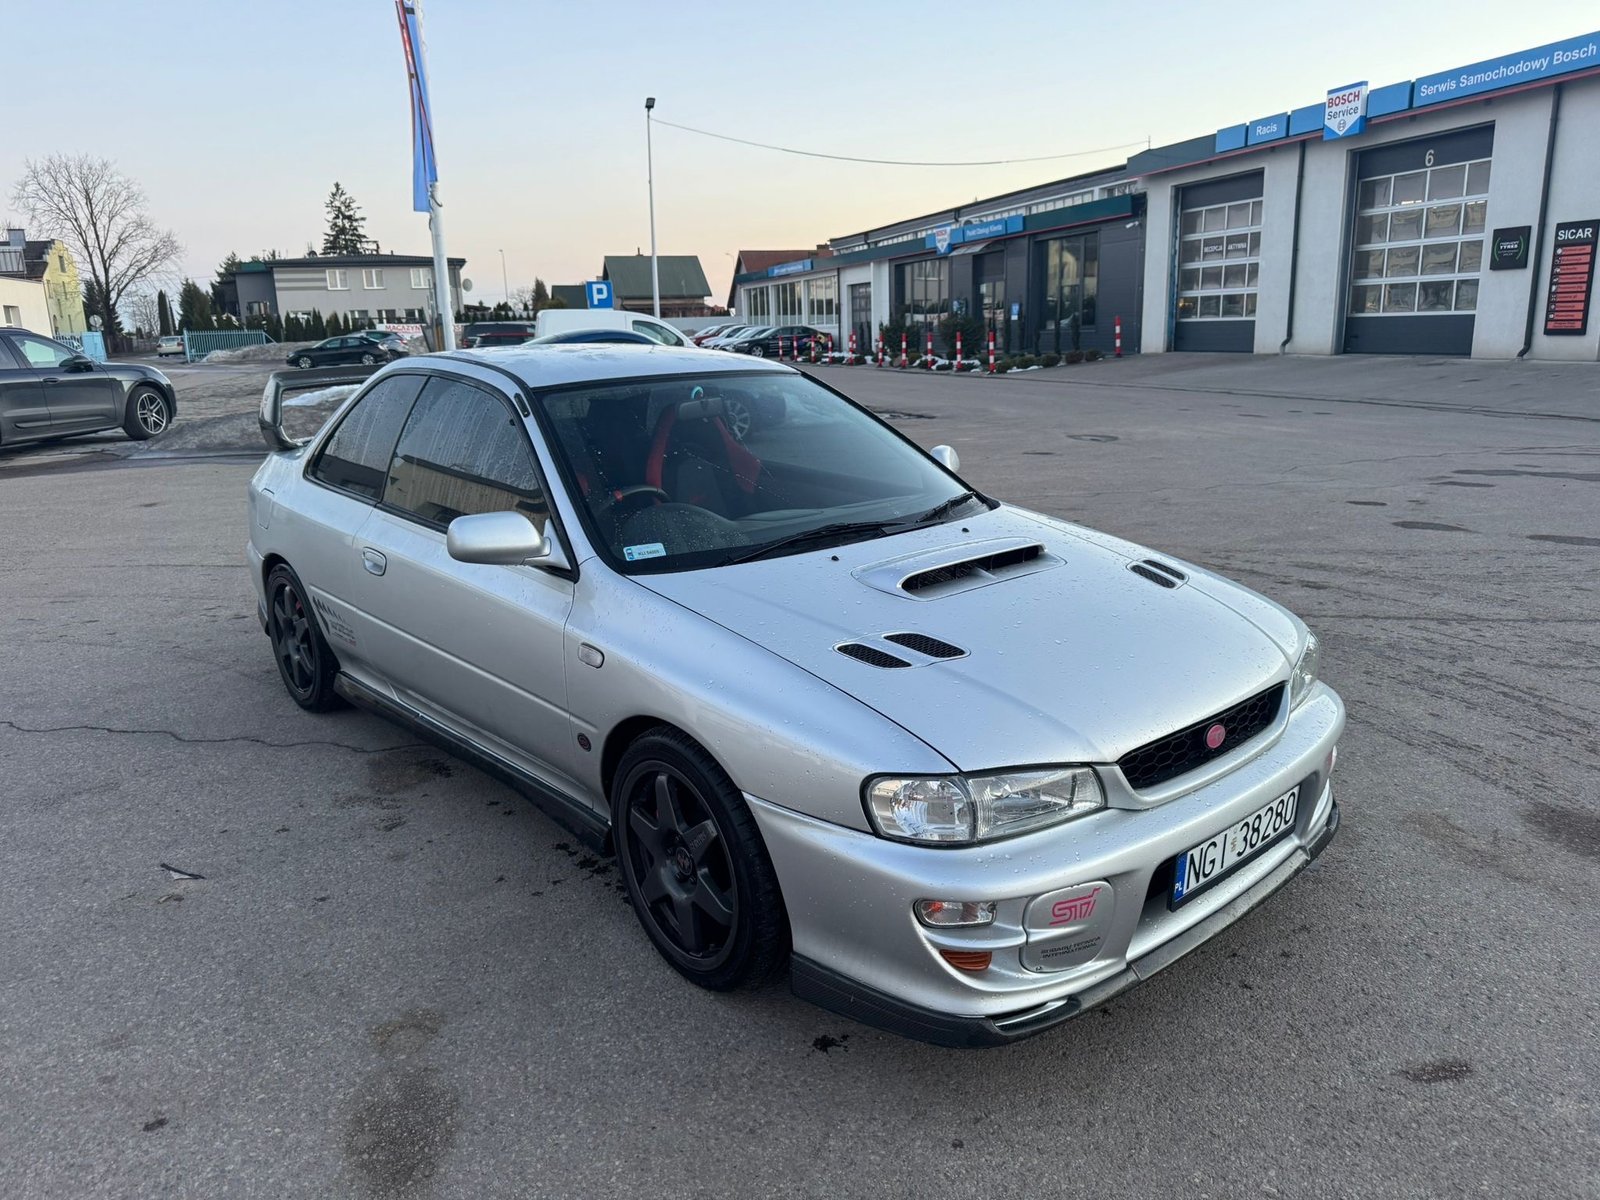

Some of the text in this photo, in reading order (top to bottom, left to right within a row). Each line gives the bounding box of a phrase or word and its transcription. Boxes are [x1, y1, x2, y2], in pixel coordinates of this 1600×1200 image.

[1420, 43, 1597, 97] Serwis Samochodowy Bosch
[1327, 90, 1361, 108] BOSCH
[1327, 105, 1359, 120] Service
[1256, 123, 1277, 136] Racis
[1425, 150, 1434, 167] 6
[1557, 228, 1592, 240] SICAR
[592, 283, 608, 305] P
[385, 325, 421, 333] MAGAZYN
[1186, 791, 1296, 890] NGI 38280
[1174, 881, 1183, 894] PL
